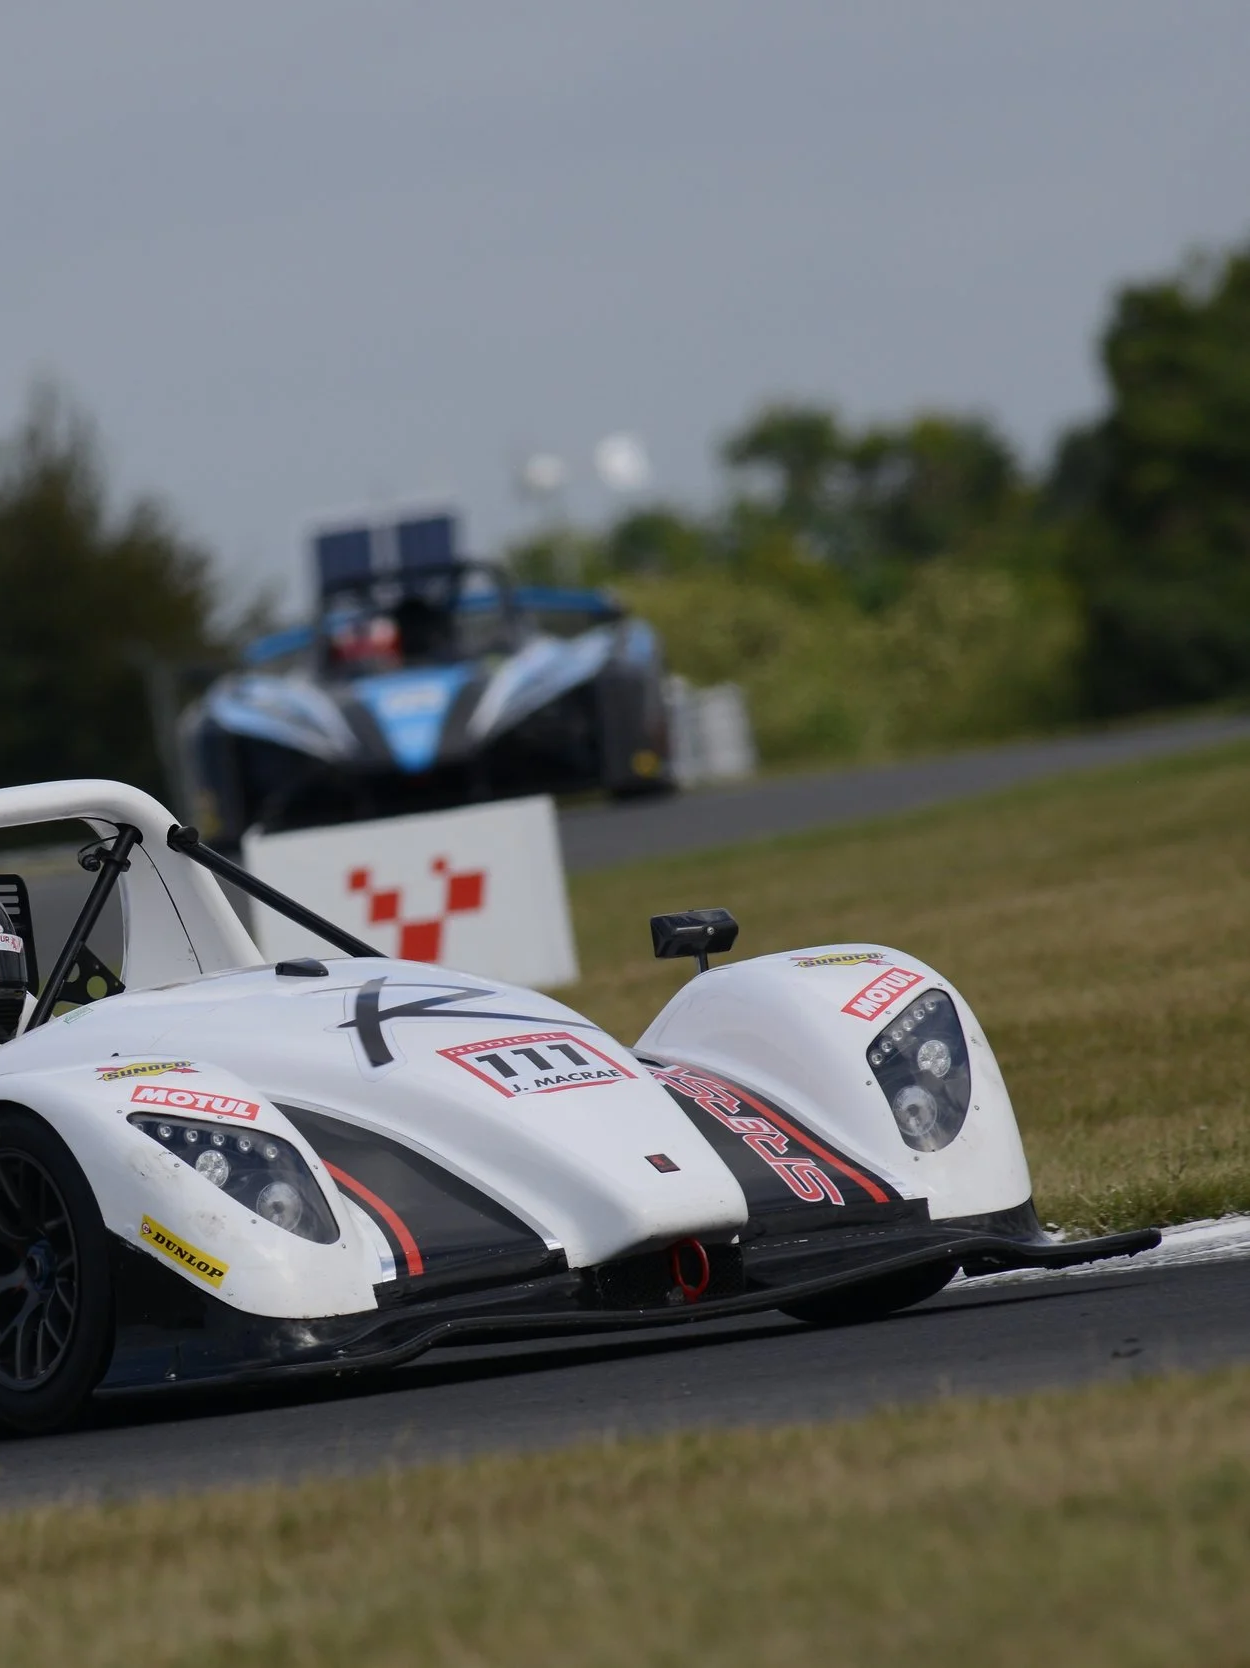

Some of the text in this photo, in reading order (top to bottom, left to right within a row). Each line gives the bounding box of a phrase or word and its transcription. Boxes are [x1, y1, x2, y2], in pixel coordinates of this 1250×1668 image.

[851, 970, 918, 1018] MOTUL
[448, 1033, 568, 1055] RADICAL
[107, 1061, 188, 1080] SUNOCO
[475, 1043, 590, 1079] 111
[512, 1069, 622, 1093] J. MACRAE
[134, 1088, 256, 1117] MOTUL
[152, 1231, 224, 1278] DUNLOP
